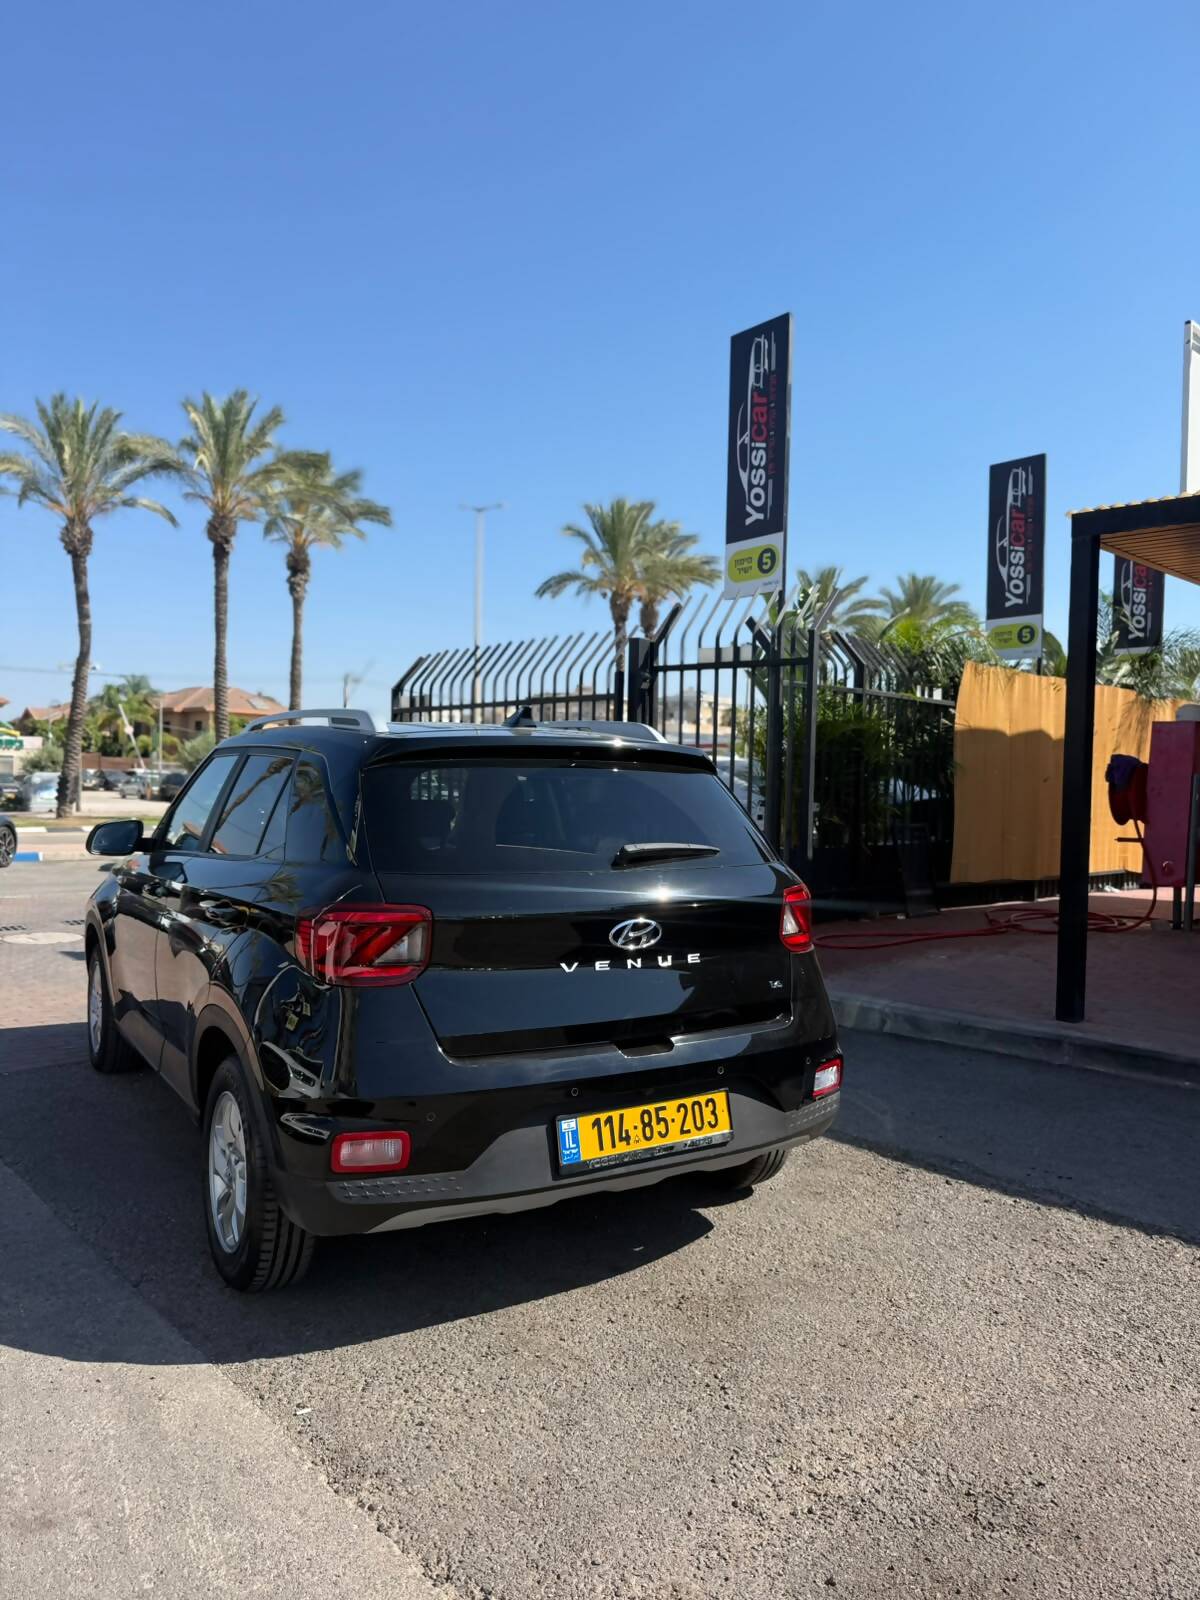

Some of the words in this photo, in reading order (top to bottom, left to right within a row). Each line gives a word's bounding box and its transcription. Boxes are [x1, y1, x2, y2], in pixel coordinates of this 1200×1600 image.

[762, 551, 772, 571] 5
[1021, 628, 1031, 642] 5
[560, 953, 702, 973] VENUE
[565, 1131, 577, 1150] IL
